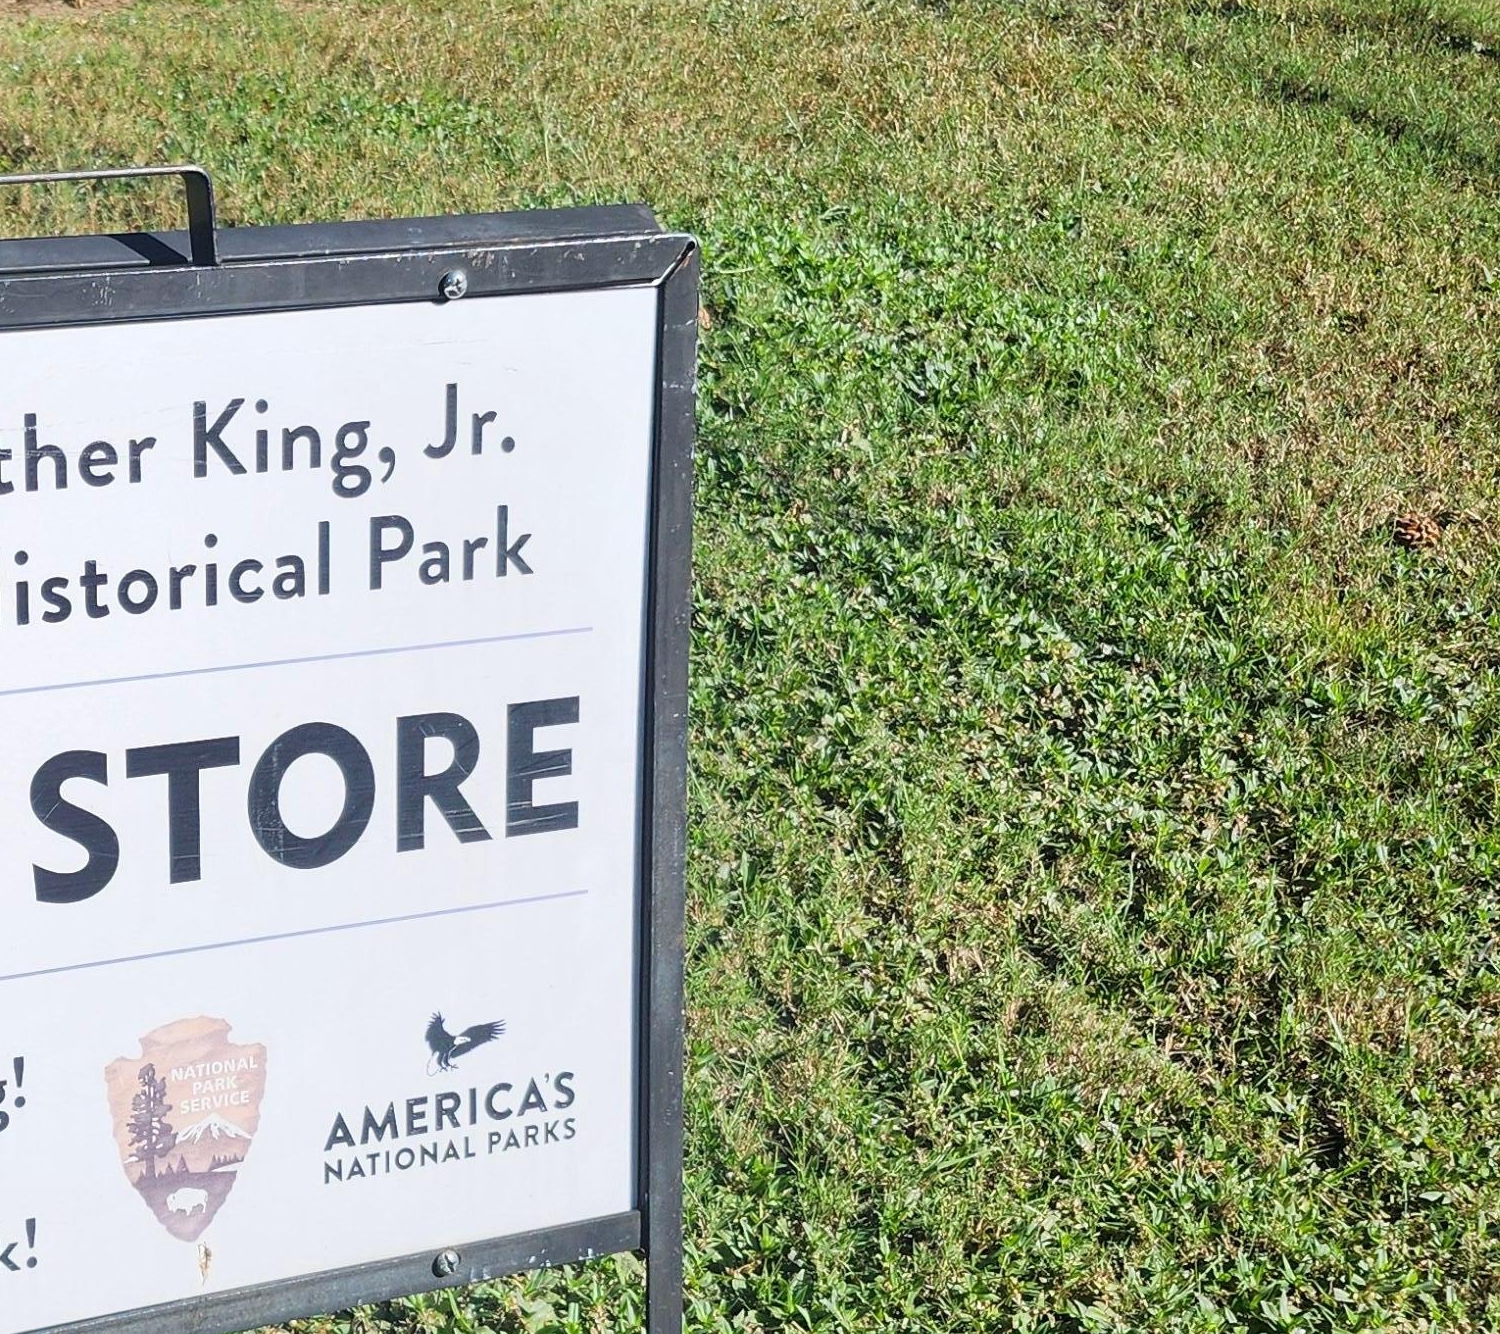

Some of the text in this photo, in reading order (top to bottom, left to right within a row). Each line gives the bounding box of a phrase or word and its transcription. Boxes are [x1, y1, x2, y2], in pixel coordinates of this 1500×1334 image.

[191, 397, 399, 500] King,
[423, 381, 517, 460] Jr.
[369, 503, 535, 591] Park
[28, 694, 581, 905] STORE
[170, 1056, 258, 1082] NATIONAL
[180, 1090, 250, 1115] SERVICE
[192, 1075, 238, 1095] PARK
[323, 1070, 576, 1152] AMERICA'S
[323, 1117, 577, 1185] NATIONAL PARKS
